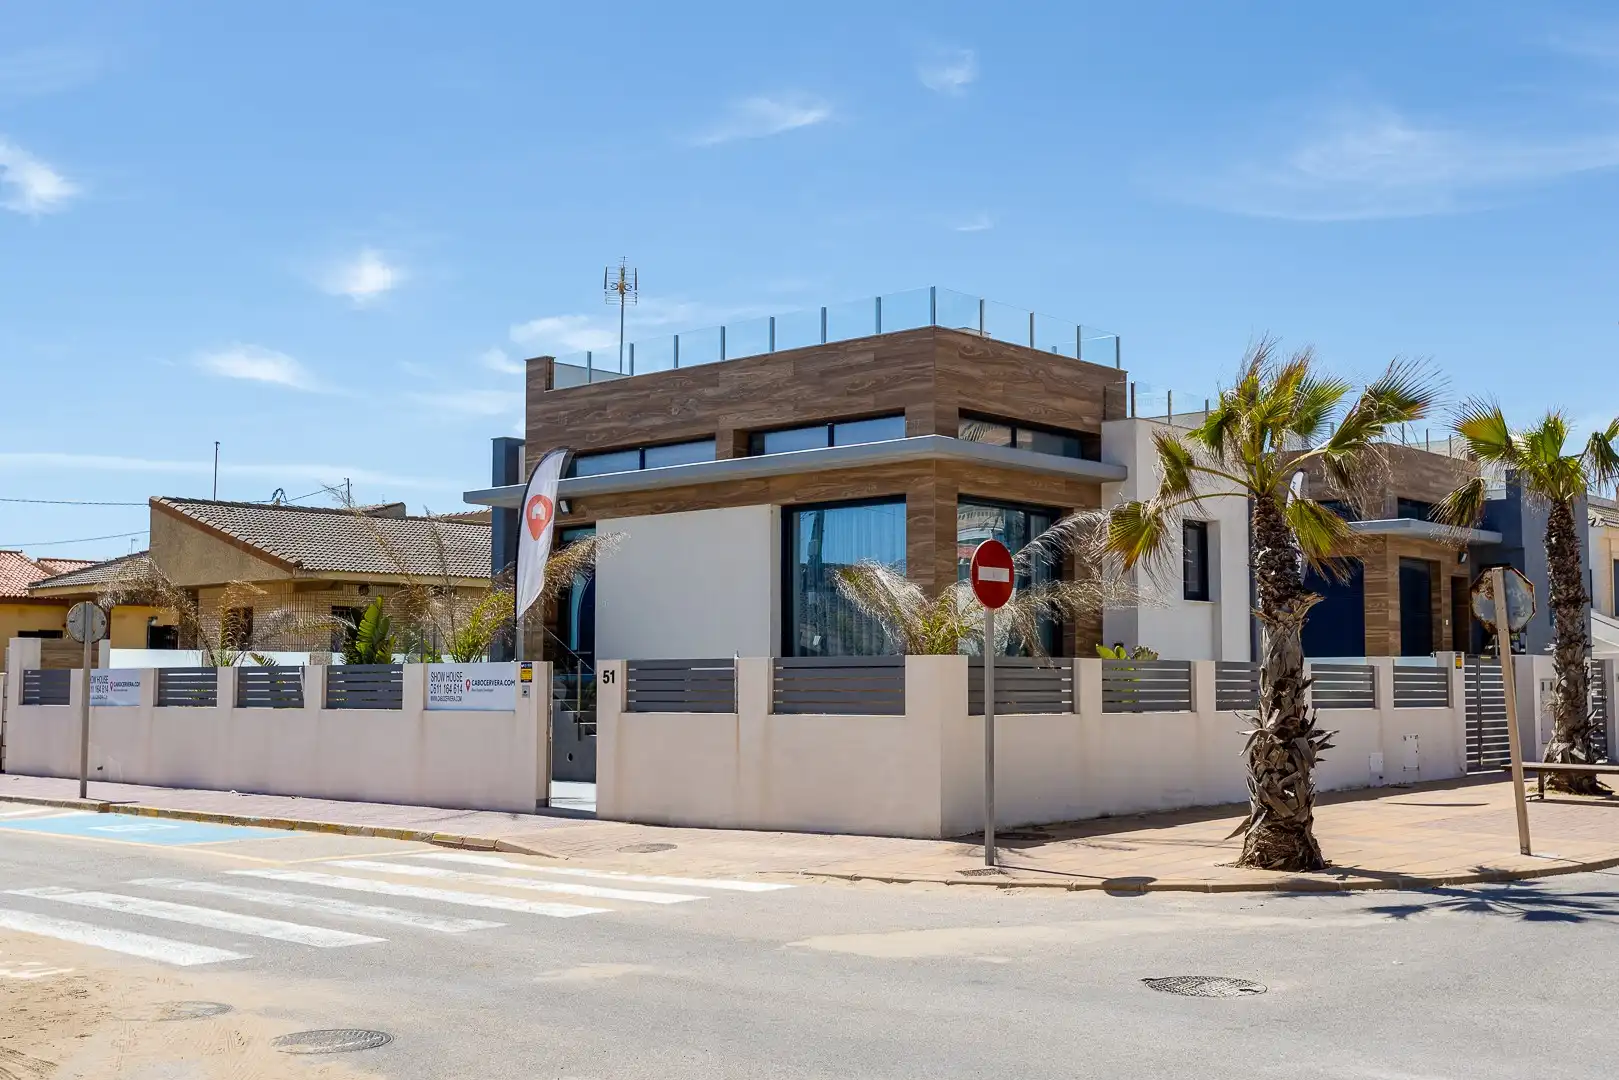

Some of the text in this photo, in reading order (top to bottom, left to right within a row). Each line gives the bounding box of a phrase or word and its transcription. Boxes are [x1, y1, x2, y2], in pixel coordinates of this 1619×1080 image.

[430, 671, 463, 682] SHOW HOUSE
[603, 670, 614, 684] 51
